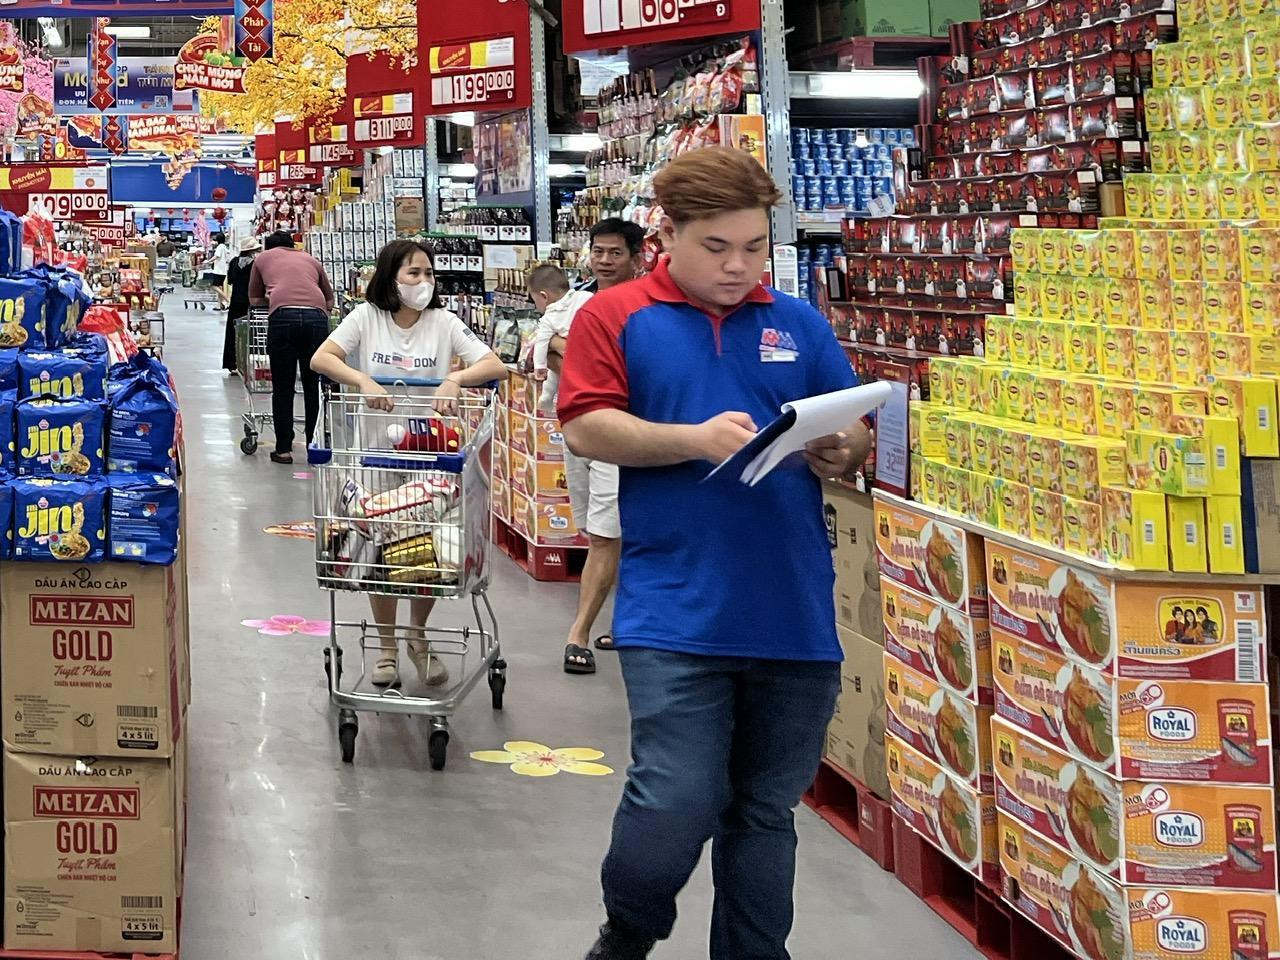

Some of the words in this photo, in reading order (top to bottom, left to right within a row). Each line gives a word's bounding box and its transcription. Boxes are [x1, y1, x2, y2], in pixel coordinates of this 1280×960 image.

[243, 16, 264, 27] Phát
[248, 42, 261, 52] Tài
[176, 62, 204, 76] CHÚC
[21, 425, 73, 458] jin
[19, 505, 72, 538] jin
[35, 601, 130, 622] MEIZAN
[52, 628, 113, 661] GOLD
[1153, 715, 1191, 731] ROYAL
[39, 793, 135, 814] MEIZAN
[56, 820, 117, 855] GOLD
[1159, 820, 1198, 837] ROYAL
[1161, 926, 1201, 942] ROYAL
